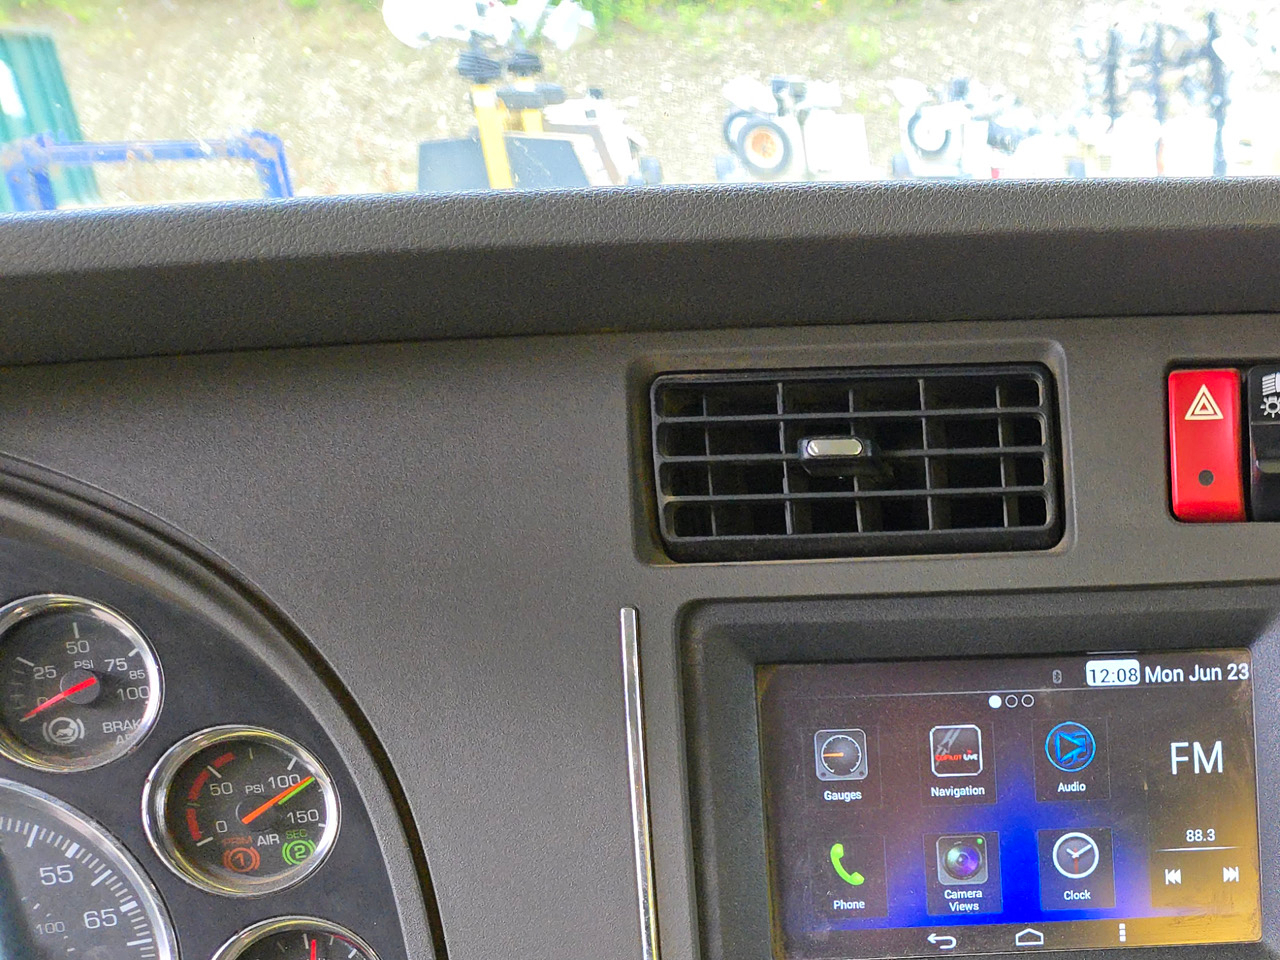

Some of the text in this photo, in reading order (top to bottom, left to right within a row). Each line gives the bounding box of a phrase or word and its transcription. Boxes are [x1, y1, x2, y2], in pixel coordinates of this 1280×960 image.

[66, 640, 90, 654] 50
[74, 660, 94, 669] PSI
[104, 658, 128, 672] 75
[33, 666, 57, 680] 25
[129, 670, 146, 680] 85
[1089, 668, 1138, 683] 12:08
[1145, 663, 1250, 684] Mon Jun 23
[117, 686, 150, 700] 100
[102, 719, 142, 734] BRAK
[1170, 740, 1224, 775] FM
[268, 774, 301, 789] 100
[1057, 781, 1087, 793] Audio
[210, 782, 233, 796] 50
[245, 784, 264, 795] PSI
[823, 790, 862, 802] Gauges
[931, 785, 985, 798] Navigation
[287, 809, 319, 824] 150
[215, 821, 228, 833] 0
[257, 834, 280, 846] AIR
[286, 829, 307, 840] SEC
[1185, 828, 1216, 843] 88.3
[39, 864, 74, 886] 55
[944, 889, 983, 900] Camera
[1063, 889, 1091, 901] Clock
[833, 899, 865, 911] Phone
[949, 901, 979, 912] Views
[83, 908, 118, 929] 65
[35, 921, 65, 935] 100
